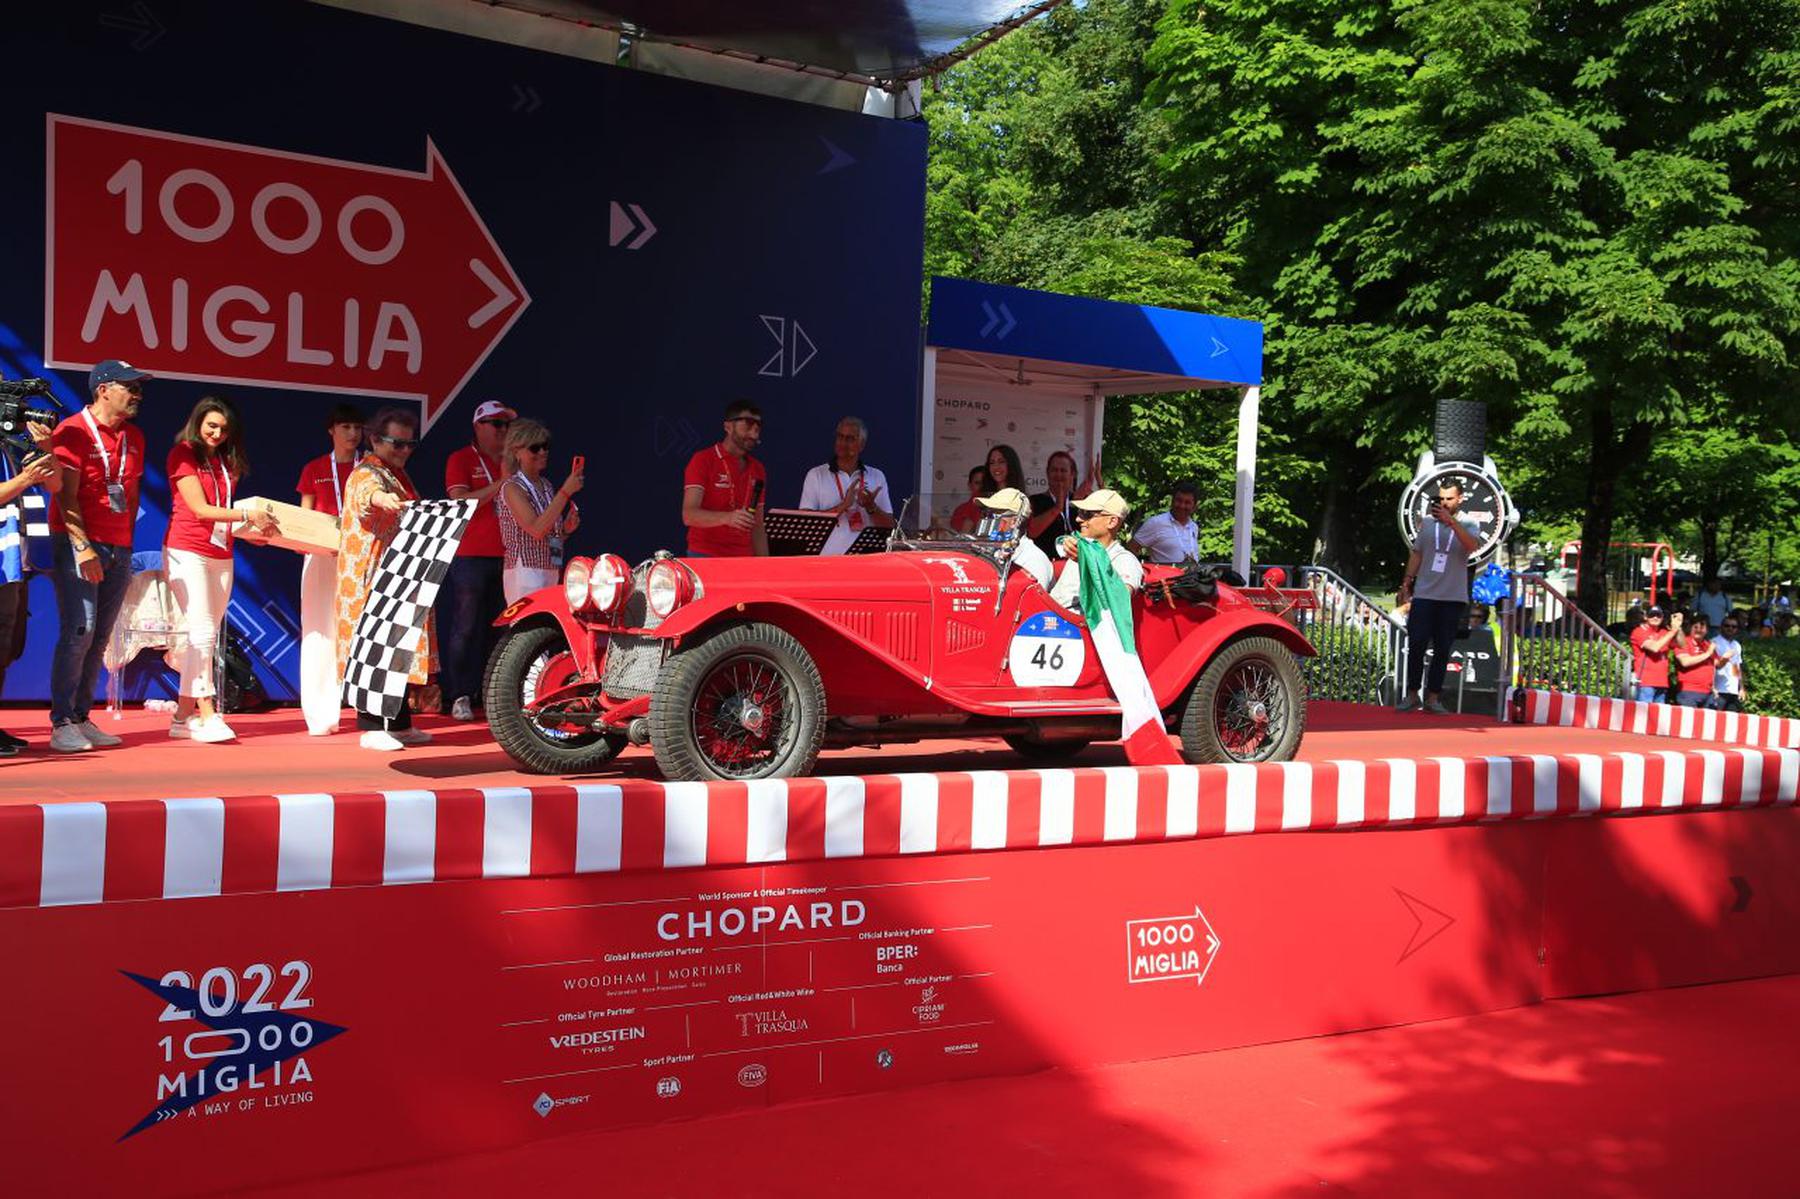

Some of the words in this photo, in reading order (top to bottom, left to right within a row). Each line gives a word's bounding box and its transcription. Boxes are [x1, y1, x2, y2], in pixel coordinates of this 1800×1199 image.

[106, 159, 406, 266] 1000
[80, 269, 423, 375] MIGLIA
[936, 399, 991, 411] CHOPARD
[1031, 643, 1064, 671] 46
[698, 893, 720, 901] World
[722, 891, 751, 901] Sponsor
[753, 890, 759, 898] &
[760, 887, 785, 897] Official
[786, 886, 827, 896] Timekeeper
[657, 900, 866, 941] CHOPARD
[859, 931, 883, 940] Official
[884, 929, 910, 939] Banking
[911, 927, 935, 936] Partner
[1137, 923, 1194, 947] 1000
[604, 952, 630, 963] Global
[631, 949, 675, 960] Restoration
[675, 947, 704, 957] Partner
[876, 944, 918, 961] BPER:
[877, 963, 904, 974] Banca
[1135, 950, 1199, 976] MIGLIA
[563, 972, 647, 990] WOODHAM
[668, 963, 742, 980] MORTIMER
[904, 976, 928, 985] Official
[929, 975, 953, 983] Partner
[158, 960, 315, 1022] 2022
[728, 993, 754, 1003] Official
[558, 1011, 586, 1022] Official
[588, 1010, 605, 1020] Tyre
[607, 1007, 636, 1017] Partner
[755, 1010, 787, 1022] VILLA
[755, 1019, 808, 1033] TRASQUA
[158, 1021, 314, 1062] 1000
[550, 1026, 645, 1048] VREDESTEIN
[581, 1045, 615, 1055] TYRES
[643, 1055, 665, 1068] Sport
[666, 1053, 695, 1064] Partner
[157, 1057, 313, 1100] MIGLIA
[658, 1079, 680, 1094] FIA
[188, 1106, 197, 1118] A
[204, 1102, 230, 1116] WAY
[239, 1099, 255, 1111] OF
[265, 1091, 314, 1108] LIVING
